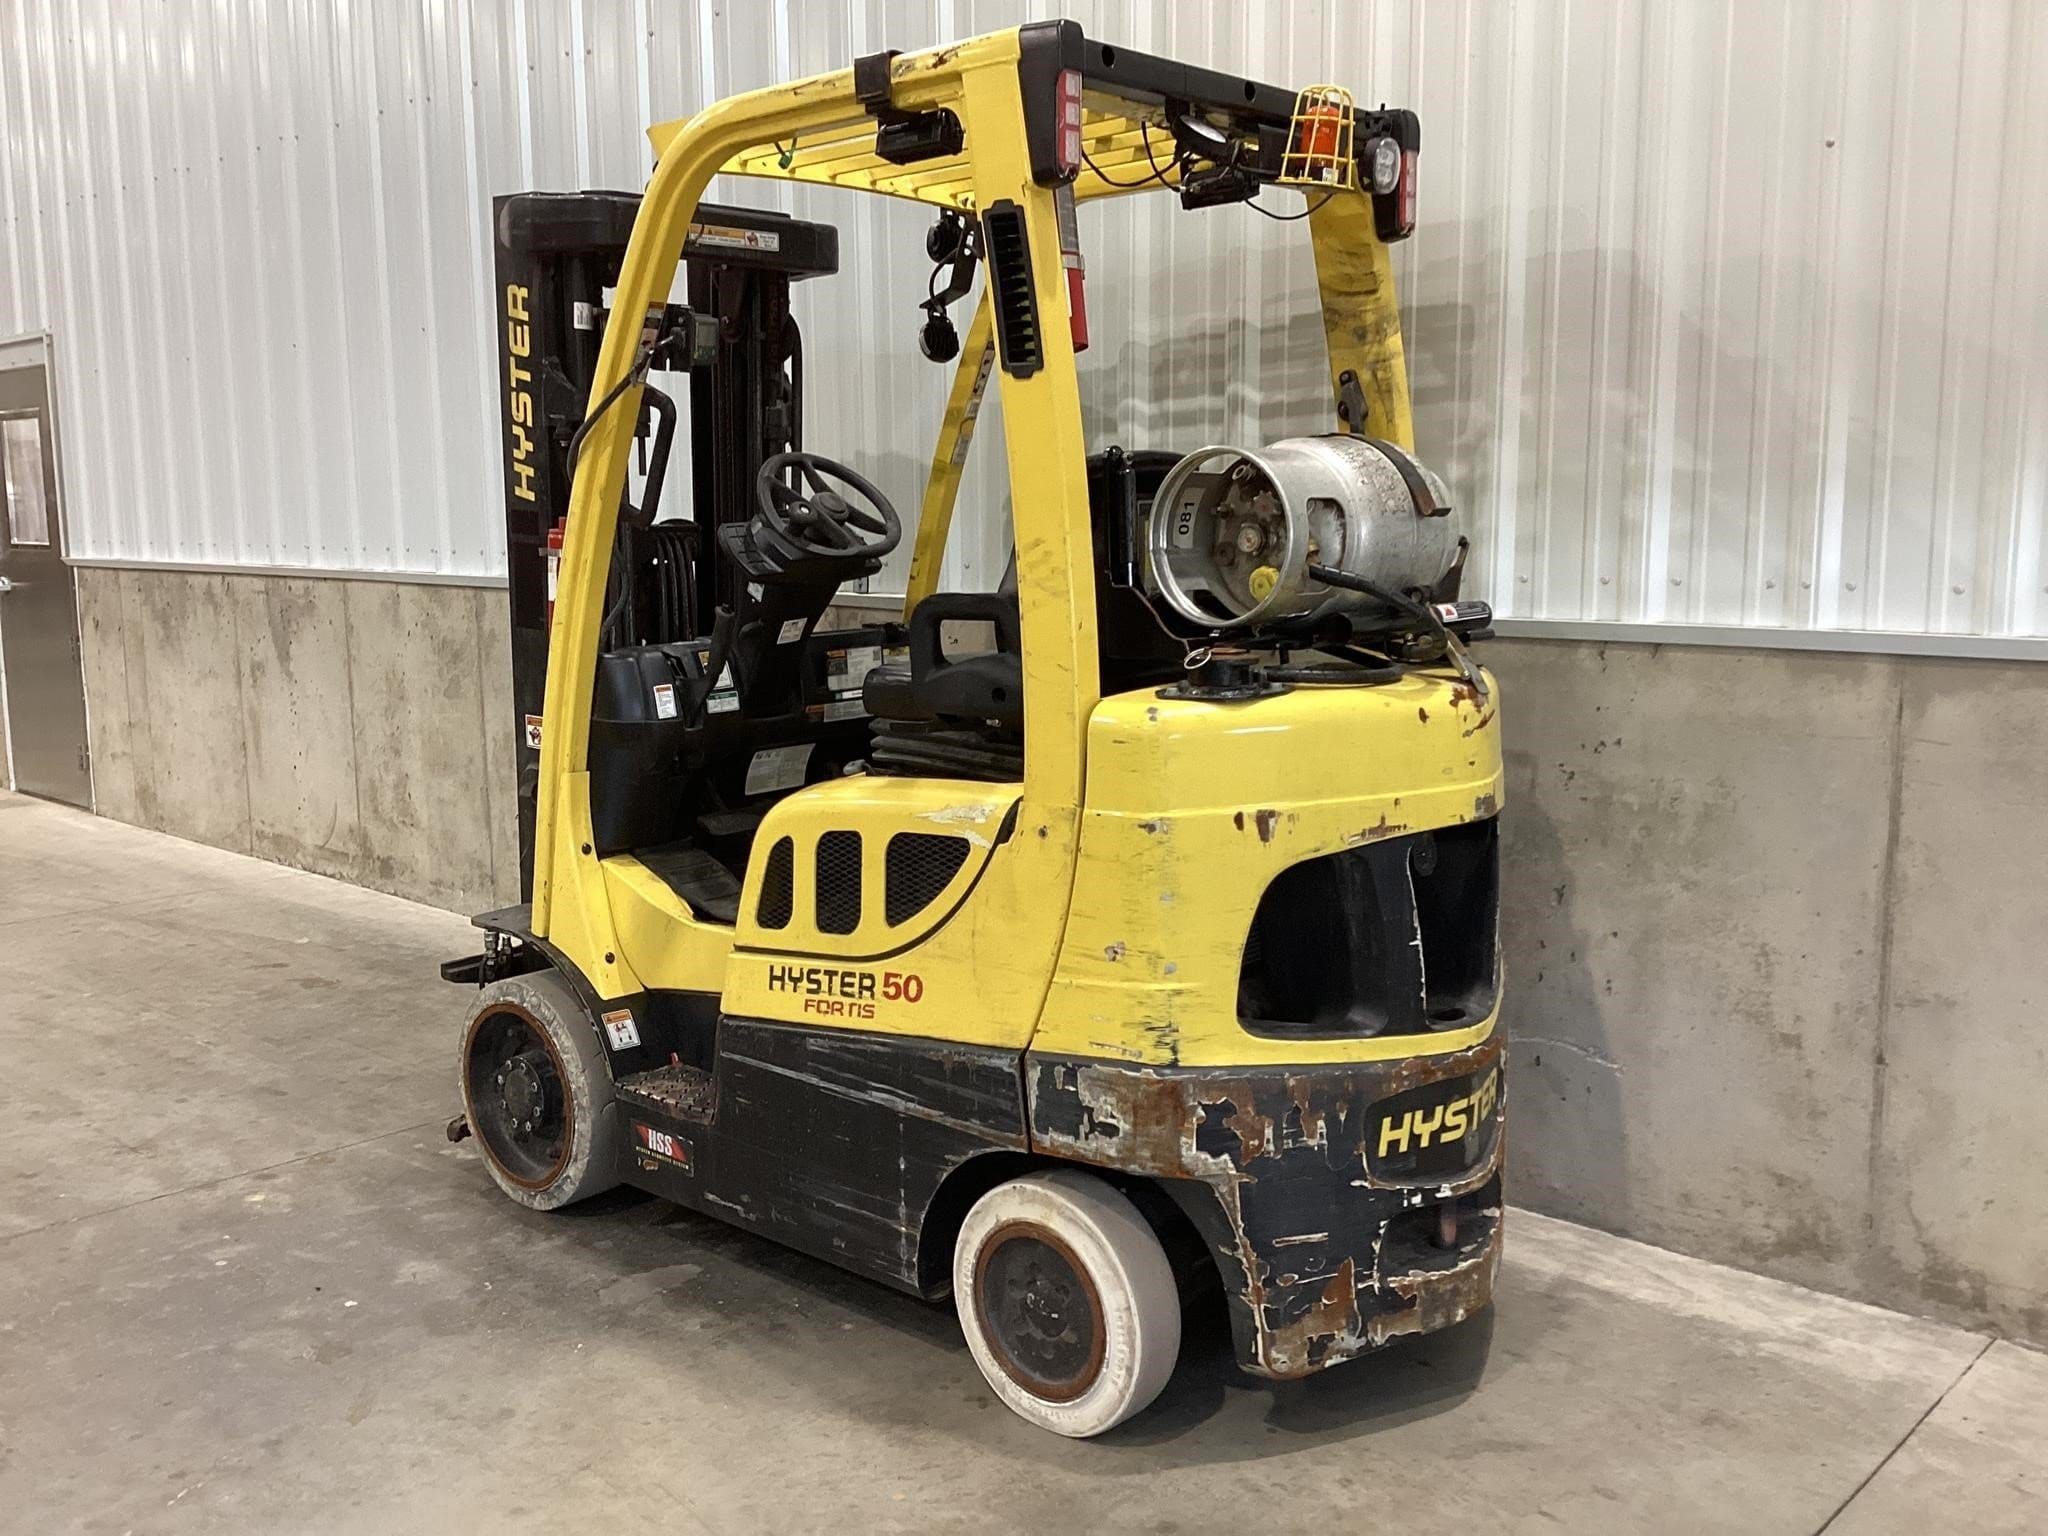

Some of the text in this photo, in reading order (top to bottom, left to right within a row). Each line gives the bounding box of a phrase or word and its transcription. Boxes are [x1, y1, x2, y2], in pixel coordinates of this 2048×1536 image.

[507, 283, 536, 502] HYSTER
[1179, 502, 1195, 535] 081
[768, 964, 924, 1004] HYSTER 50
[804, 998, 875, 1019] FORTIS
[1378, 1066, 1498, 1158] HYSTER
[647, 1128, 673, 1156] HSS
